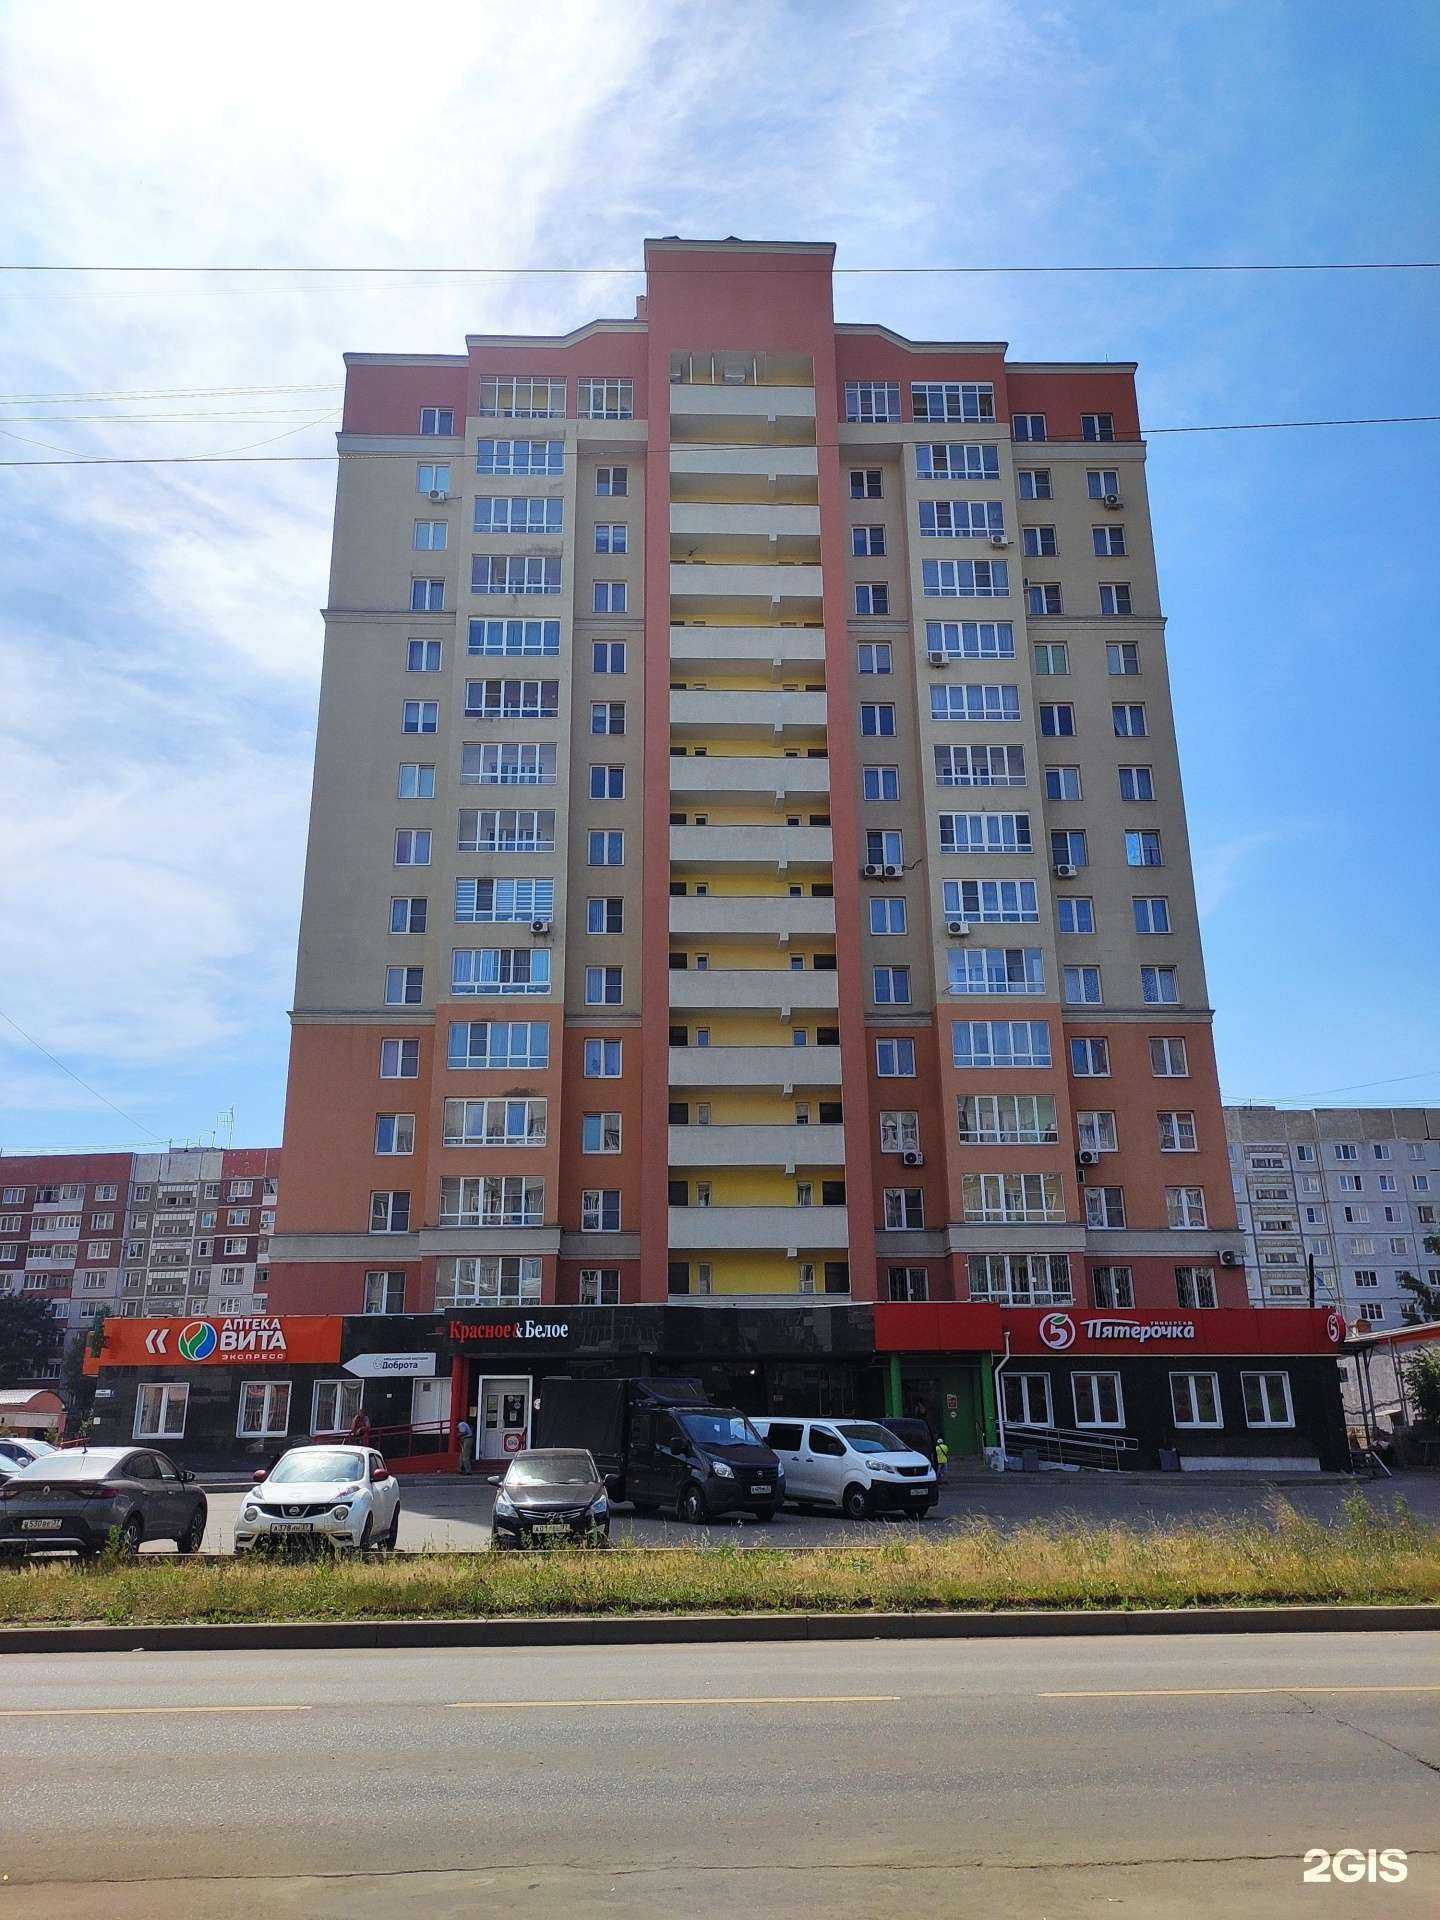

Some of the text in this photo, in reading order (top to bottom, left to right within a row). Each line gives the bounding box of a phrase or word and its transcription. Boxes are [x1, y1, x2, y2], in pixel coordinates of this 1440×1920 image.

[222, 1318, 281, 1330] АПТЕКА
[1080, 1318, 1195, 1343] Пятерочка
[220, 1331, 287, 1351] ВИТА
[382, 1361, 418, 1371] Доброта
